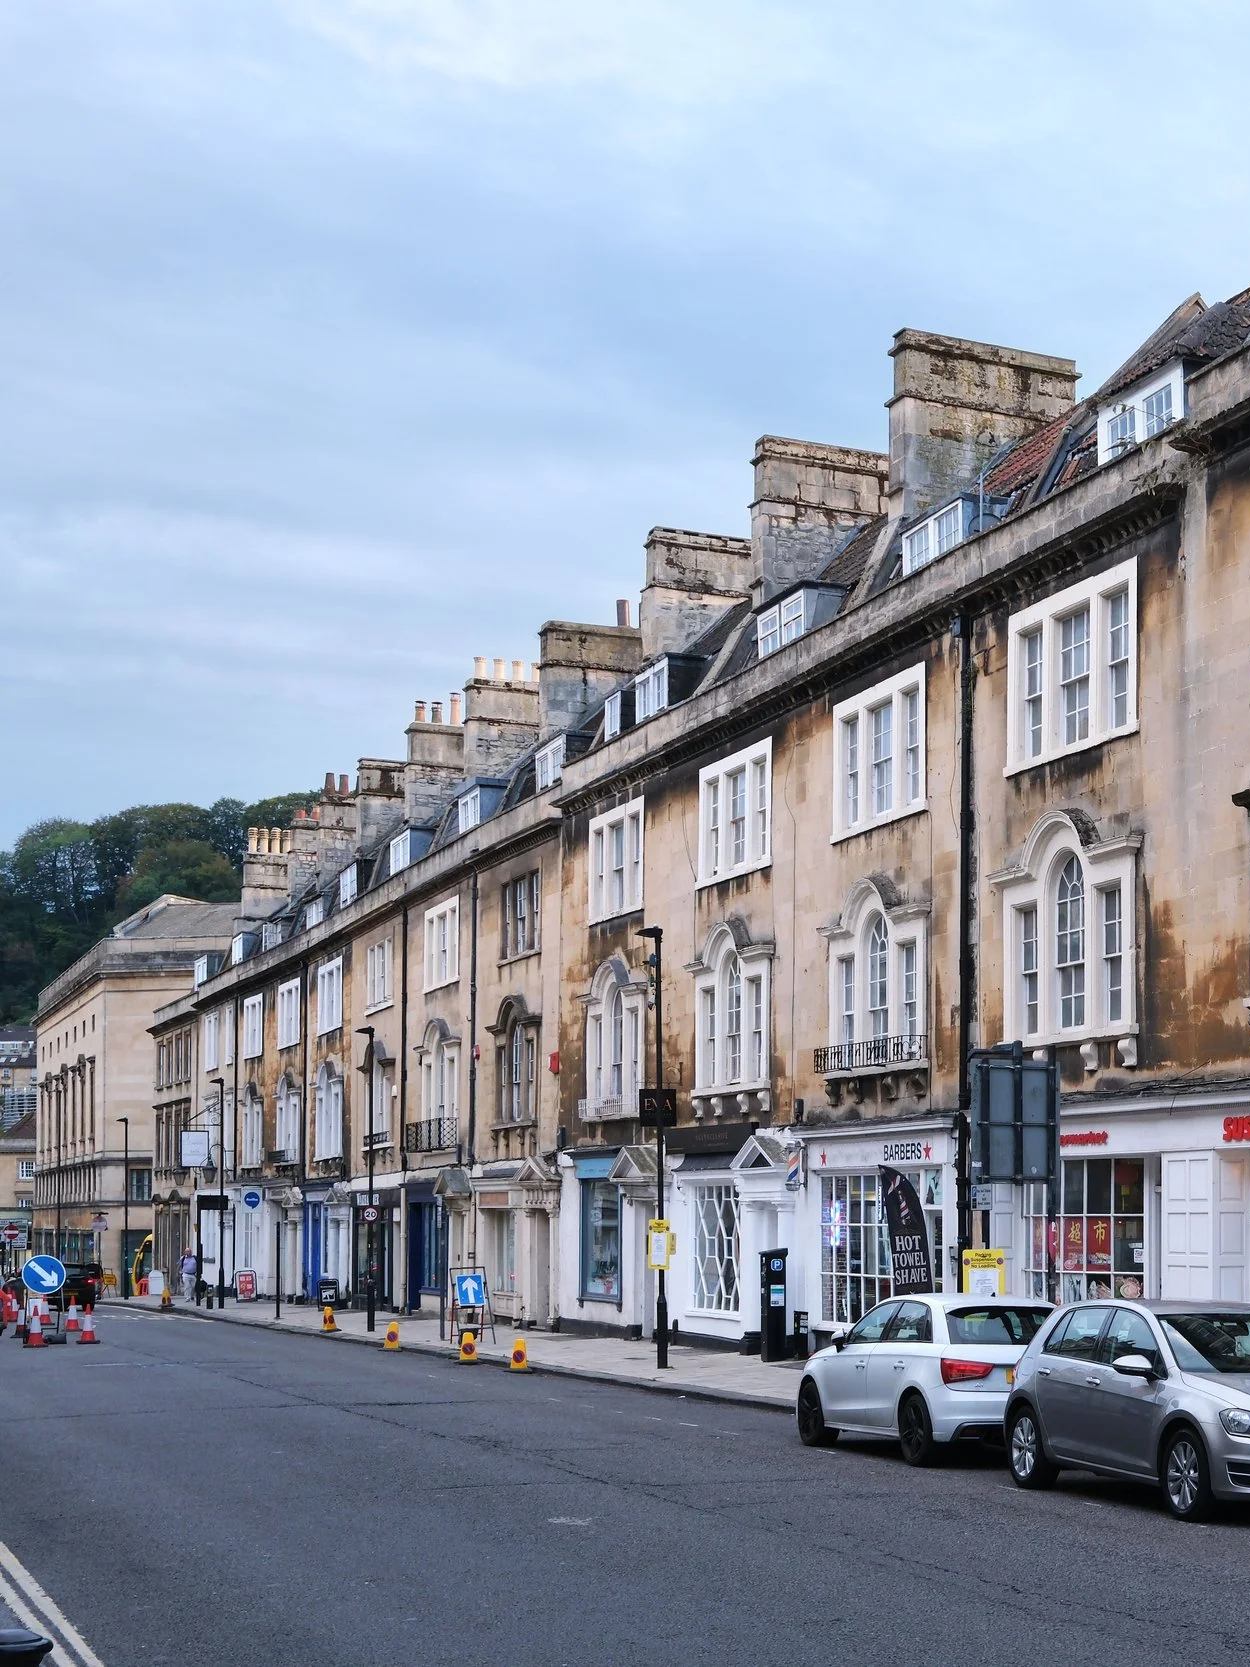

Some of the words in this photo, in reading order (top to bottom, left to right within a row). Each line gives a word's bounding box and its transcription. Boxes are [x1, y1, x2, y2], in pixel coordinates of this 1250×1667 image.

[883, 1142, 922, 1161] BARBERS
[895, 1235, 921, 1252] HOT
[893, 1252, 927, 1268] TOWEL
[895, 1268, 928, 1286] SHAVE
